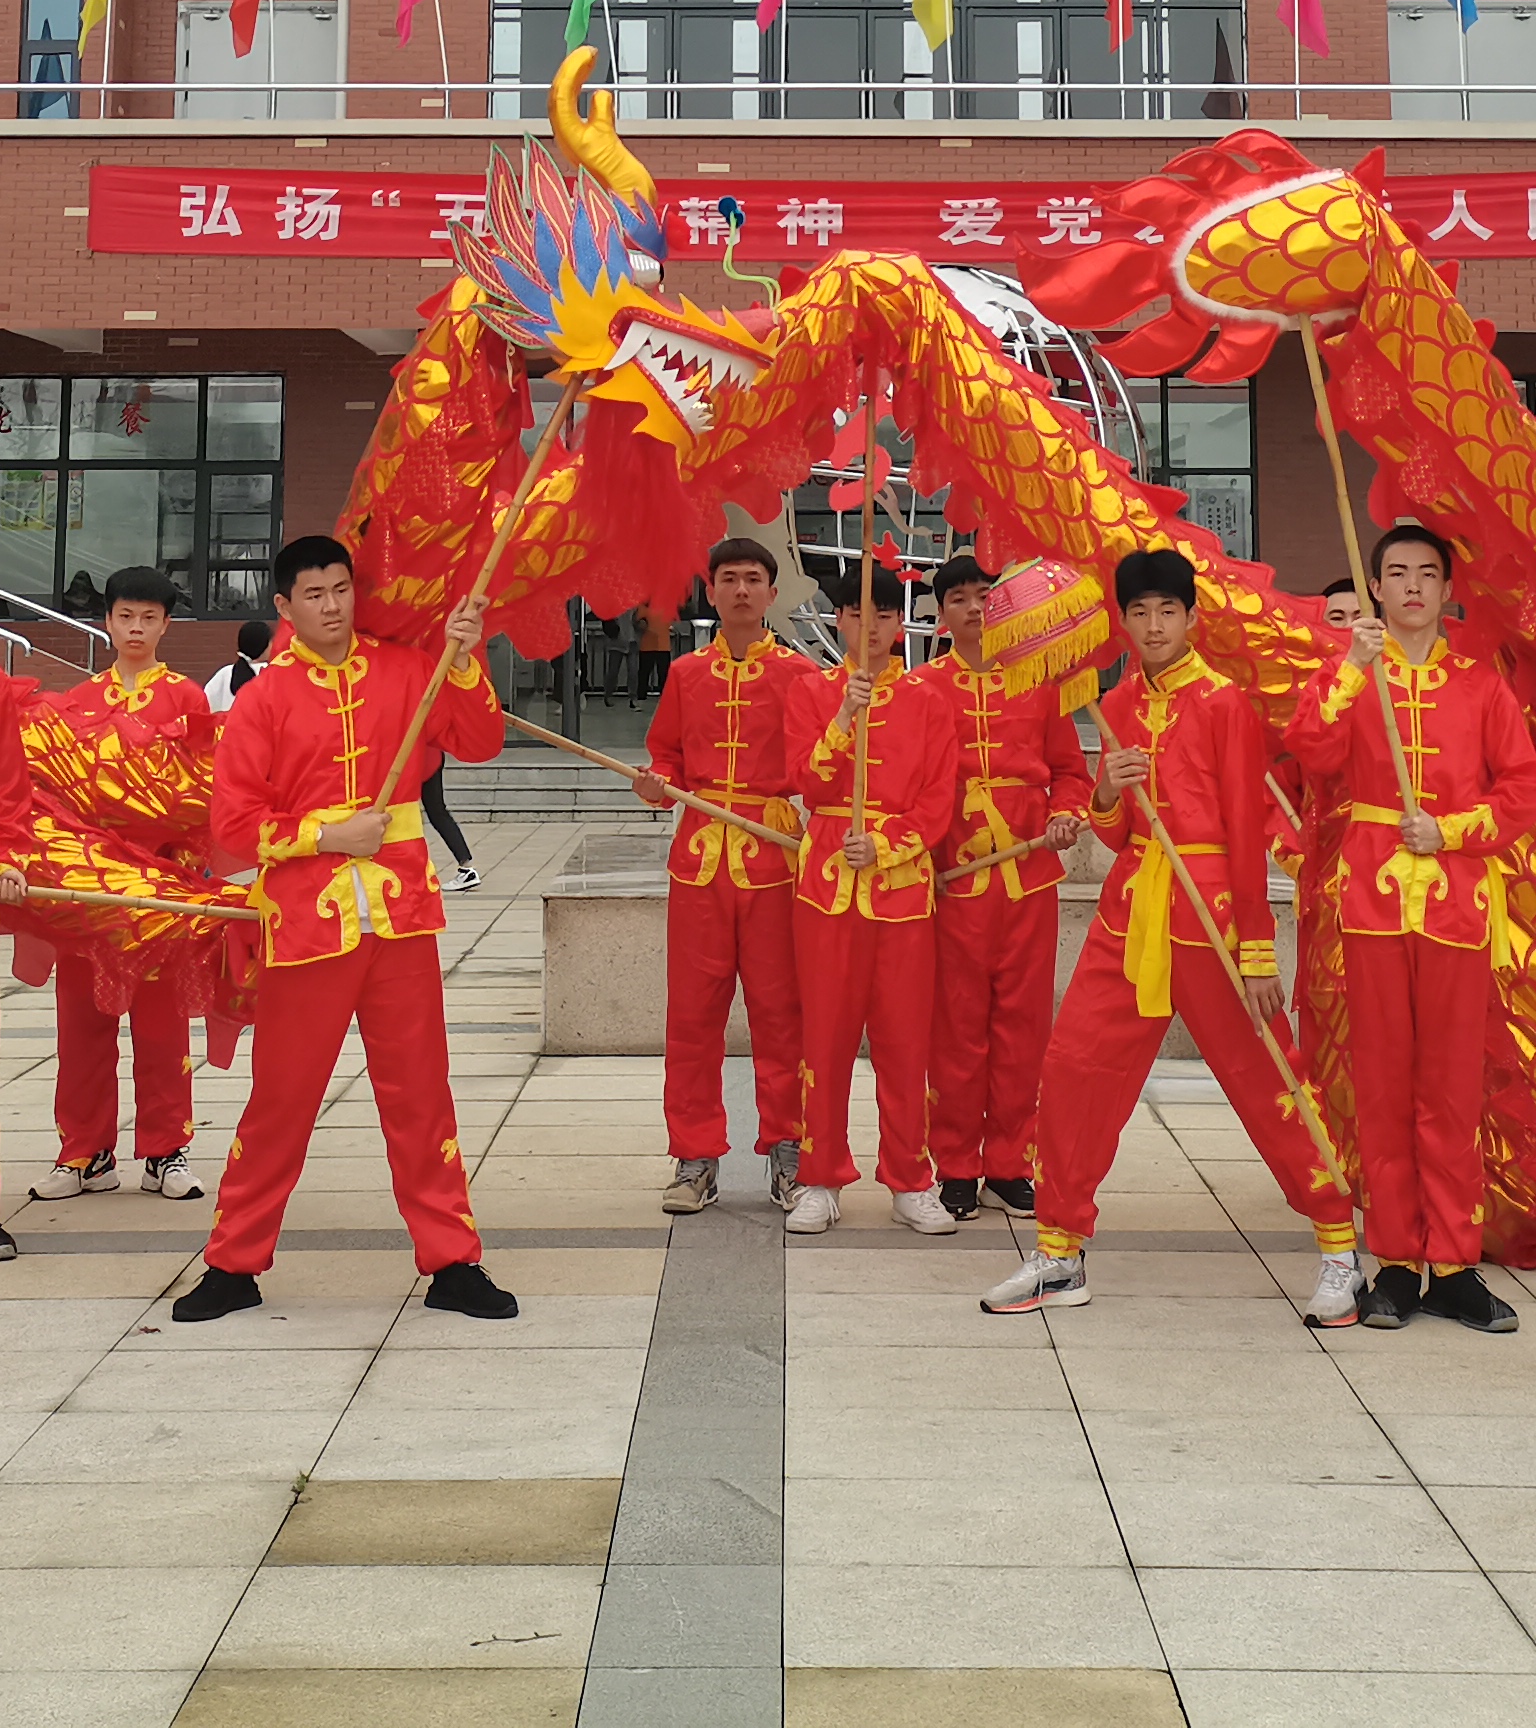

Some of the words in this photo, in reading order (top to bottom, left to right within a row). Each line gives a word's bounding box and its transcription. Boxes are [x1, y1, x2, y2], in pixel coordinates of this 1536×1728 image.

[179, 184, 844, 247] 弘扬“五精神
